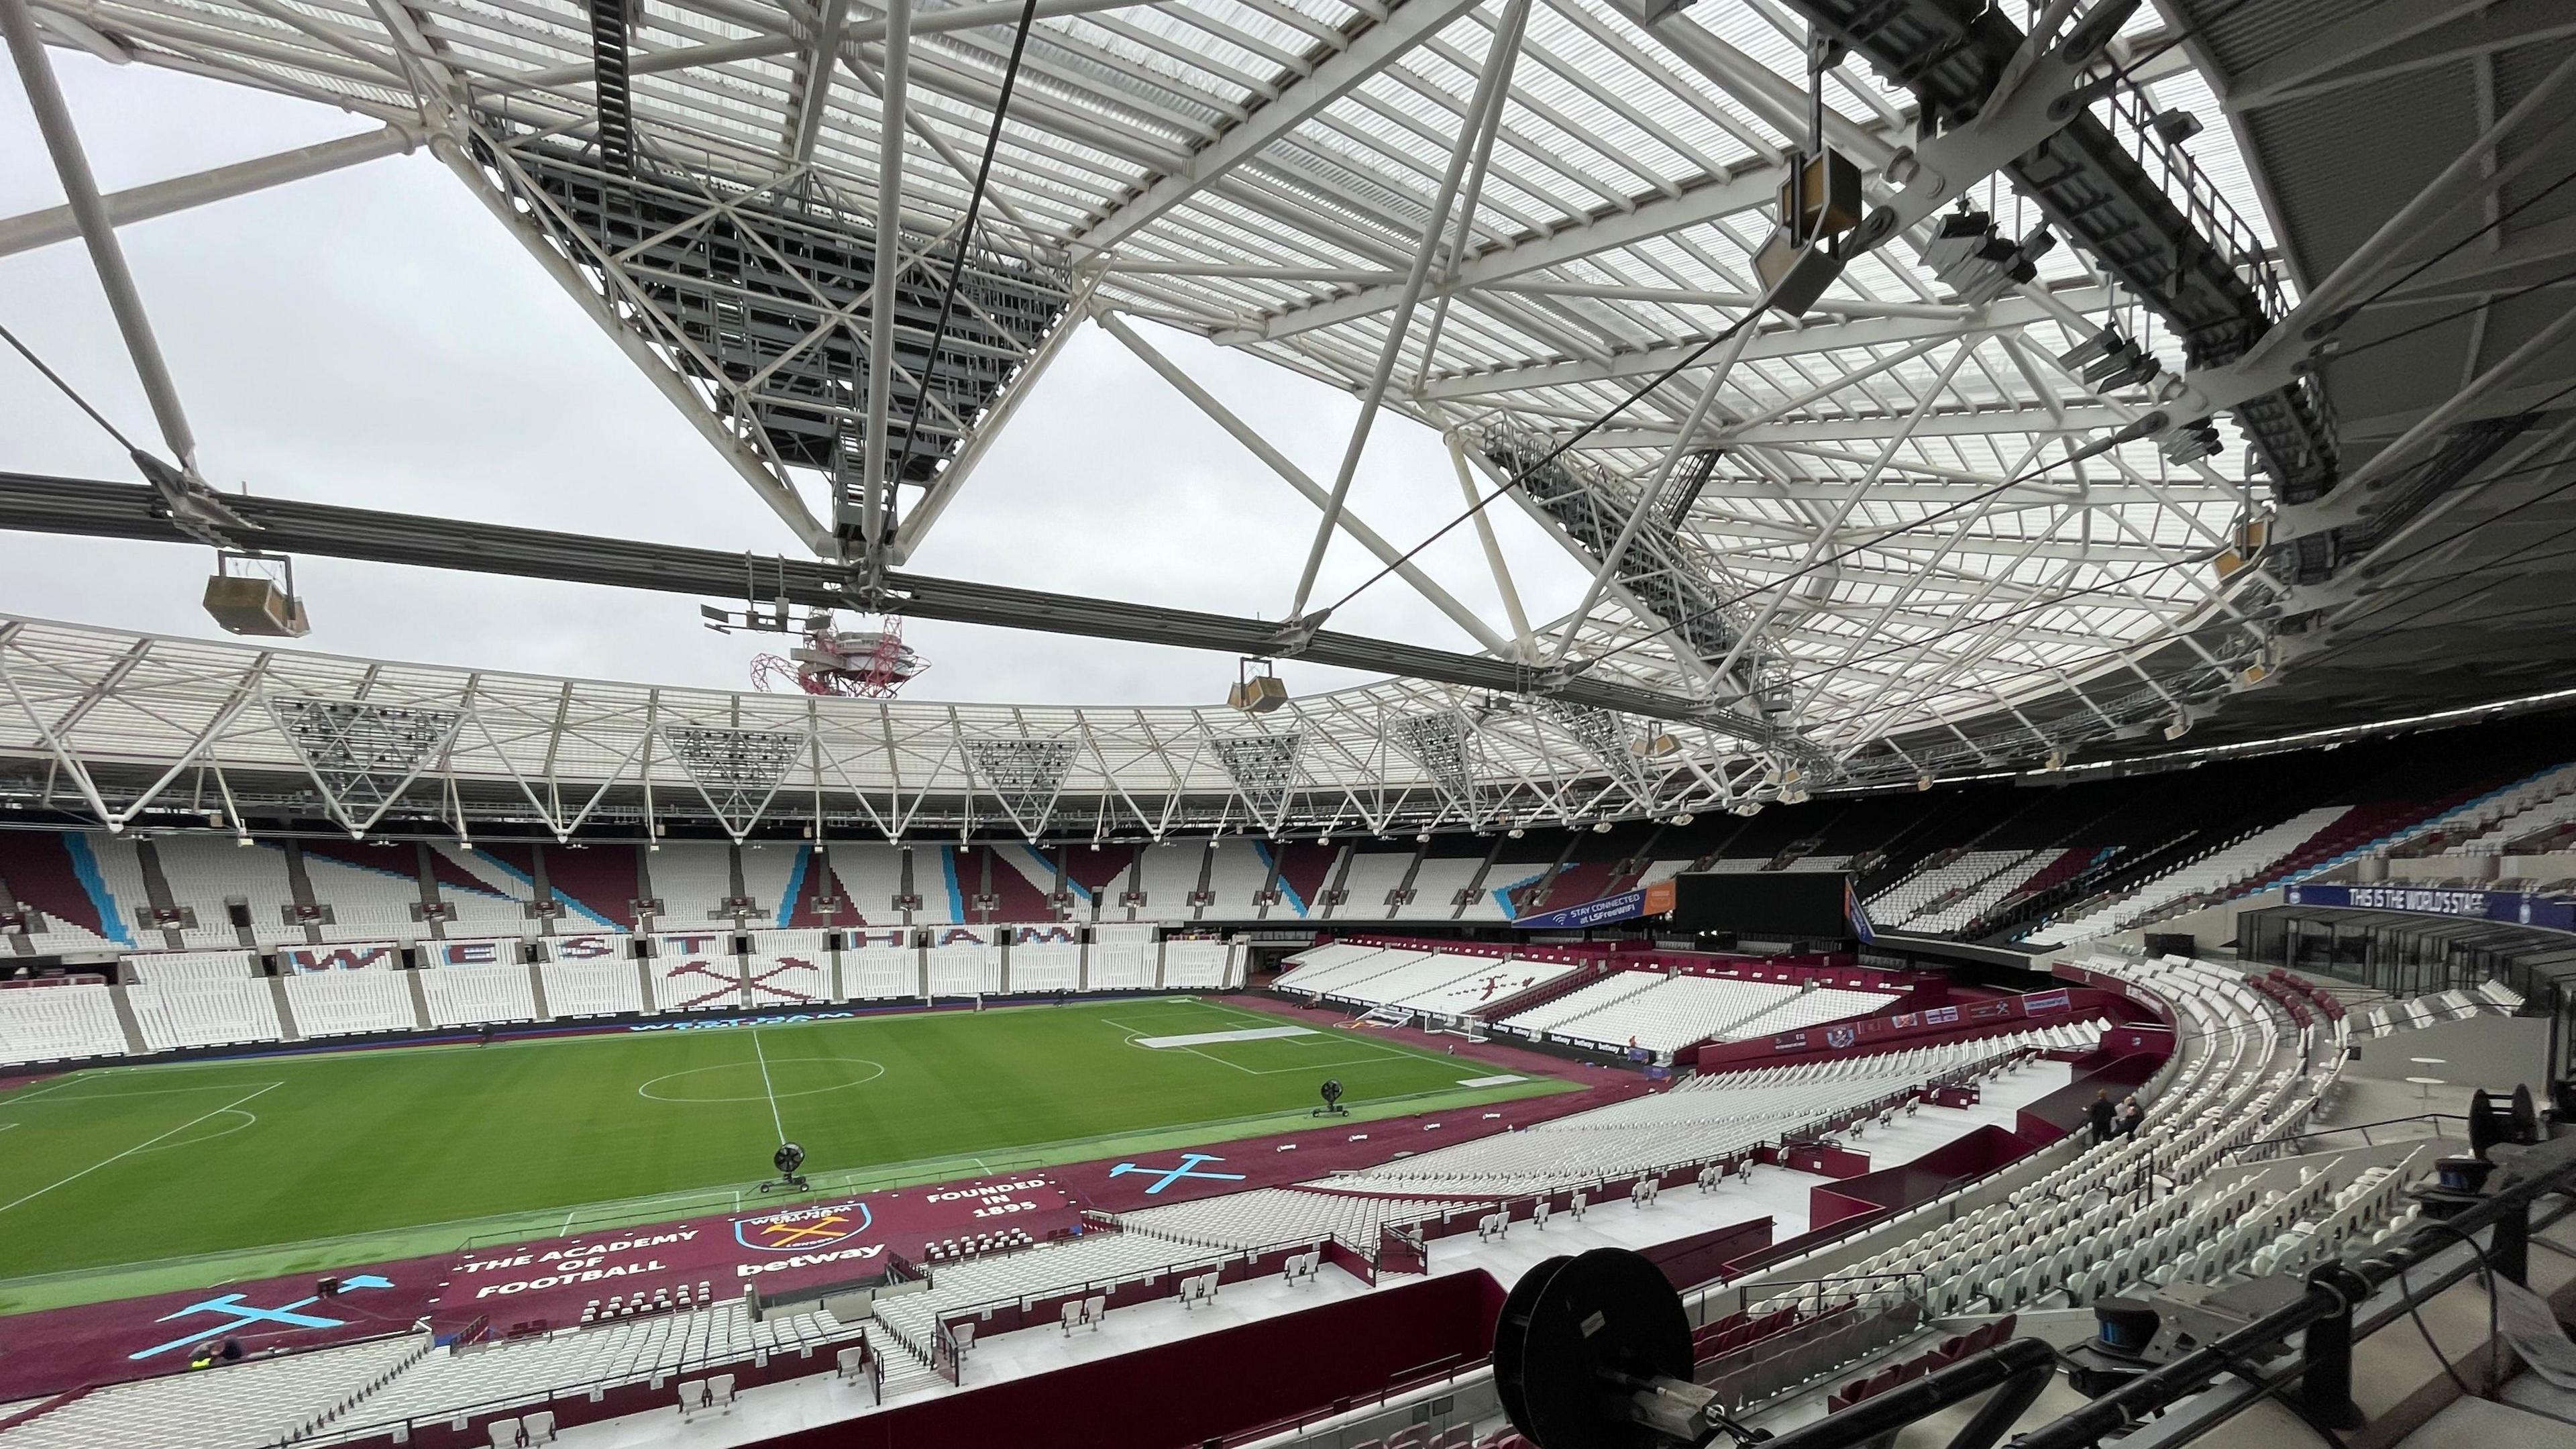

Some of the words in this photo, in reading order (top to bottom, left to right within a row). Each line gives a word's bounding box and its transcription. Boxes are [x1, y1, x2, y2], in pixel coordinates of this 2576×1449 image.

[1570, 906, 1591, 918] STAY
[1591, 894, 1641, 912] CONNECTED
[2349, 888, 2373, 907] THIS
[2373, 889, 2383, 907] IS
[2385, 890, 2404, 909] THE
[926, 1179, 1045, 1203] FOUNDED
[981, 1194, 1010, 1205] IN
[973, 1201, 1037, 1218] 1895
[464, 1254, 534, 1273] THE
[538, 1230, 699, 1263] ACADEMY
[786, 1237, 834, 1248] LONDON
[557, 1256, 605, 1271] OF
[737, 1244, 885, 1277] betway
[476, 1260, 666, 1299] FOOTBALL
